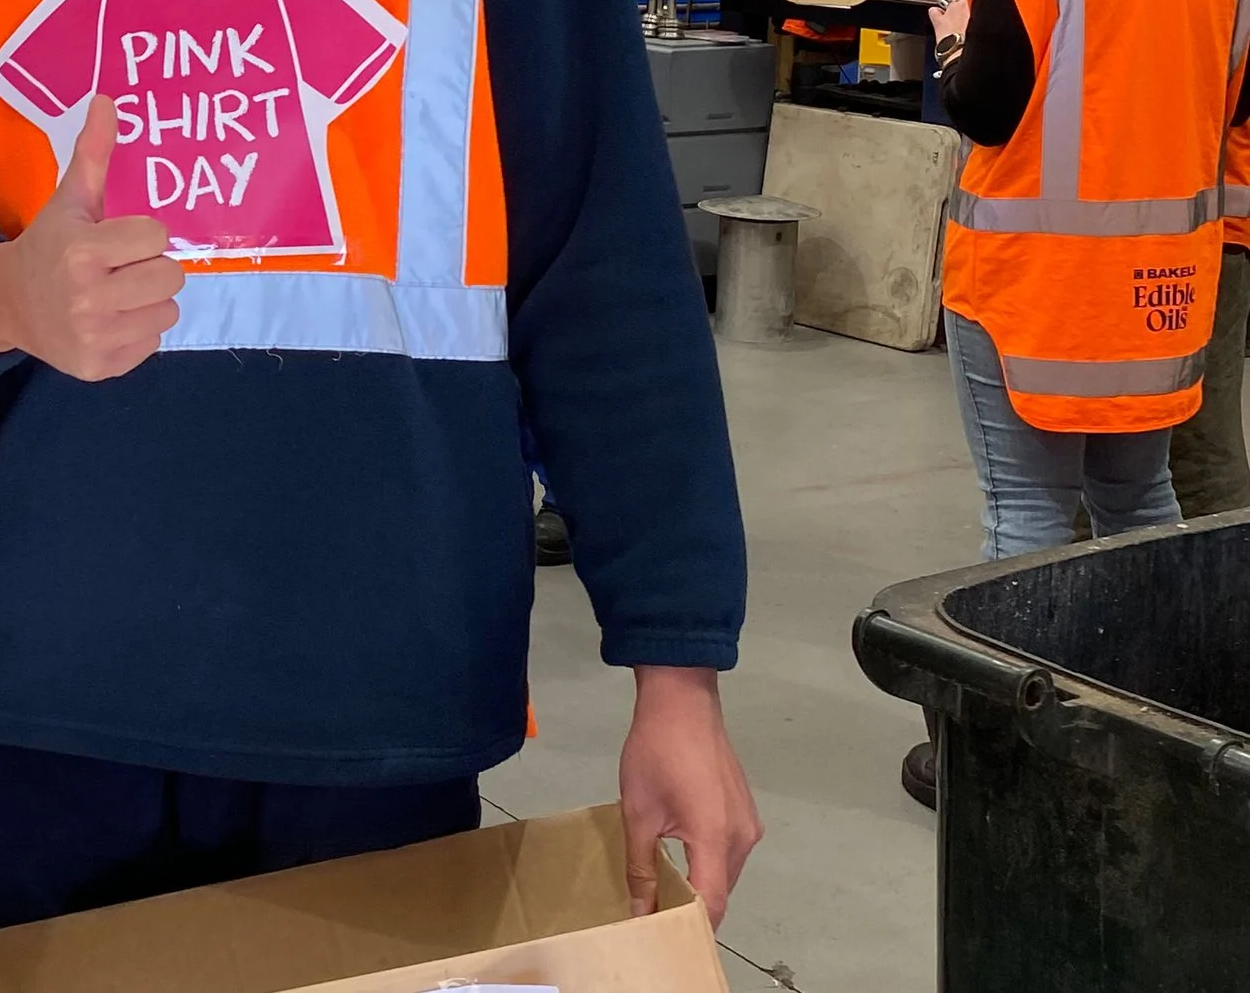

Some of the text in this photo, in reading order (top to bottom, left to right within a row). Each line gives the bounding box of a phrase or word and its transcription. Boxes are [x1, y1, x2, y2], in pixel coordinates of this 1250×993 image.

[121, 23, 275, 86] PINK
[113, 88, 290, 146] SHIRT
[146, 152, 259, 211] DAY
[1134, 283, 1195, 308] Edible
[1146, 308, 1188, 332] Oils
